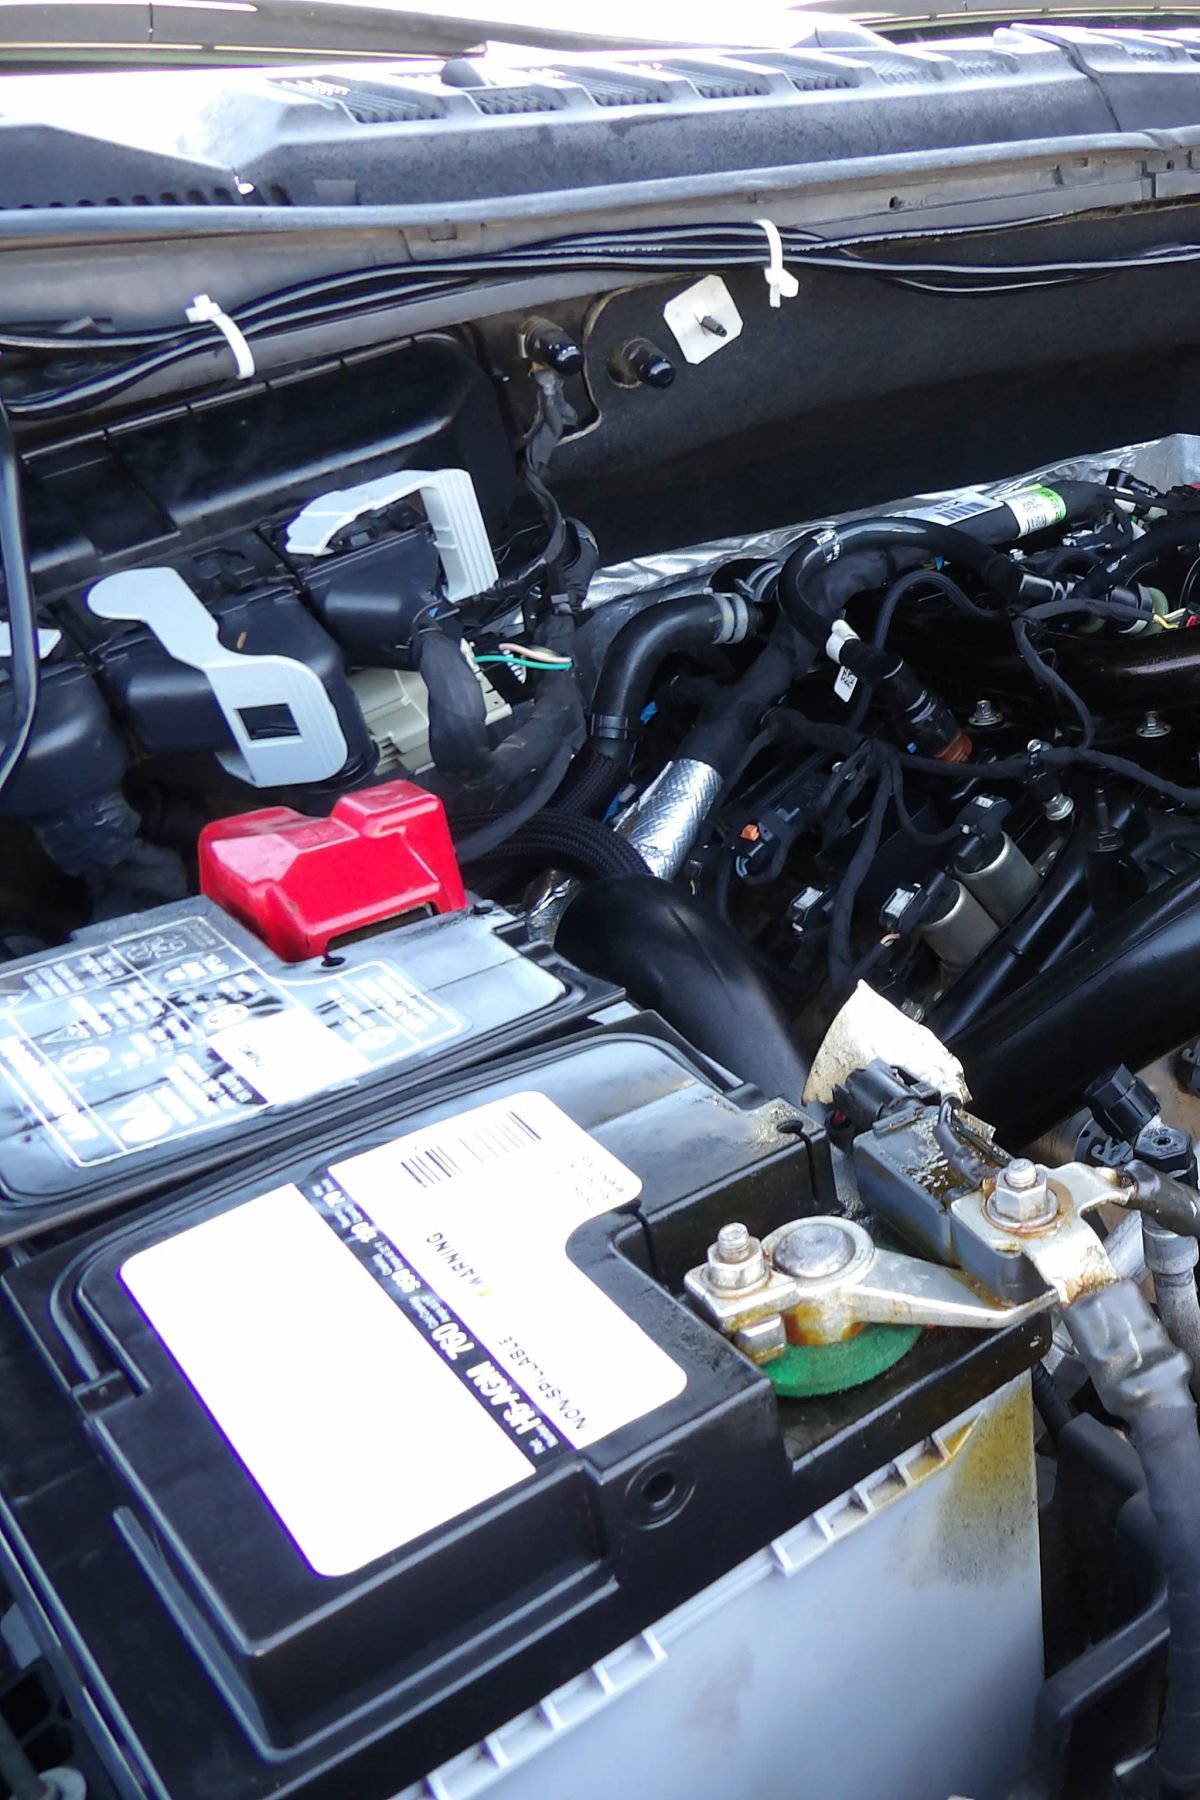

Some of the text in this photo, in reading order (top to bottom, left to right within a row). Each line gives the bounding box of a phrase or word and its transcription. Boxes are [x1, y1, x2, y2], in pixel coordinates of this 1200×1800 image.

[426, 1231, 483, 1287] WARNING
[432, 1320, 475, 1361] 760
[498, 1335, 589, 1431] NON-SPILLABLE
